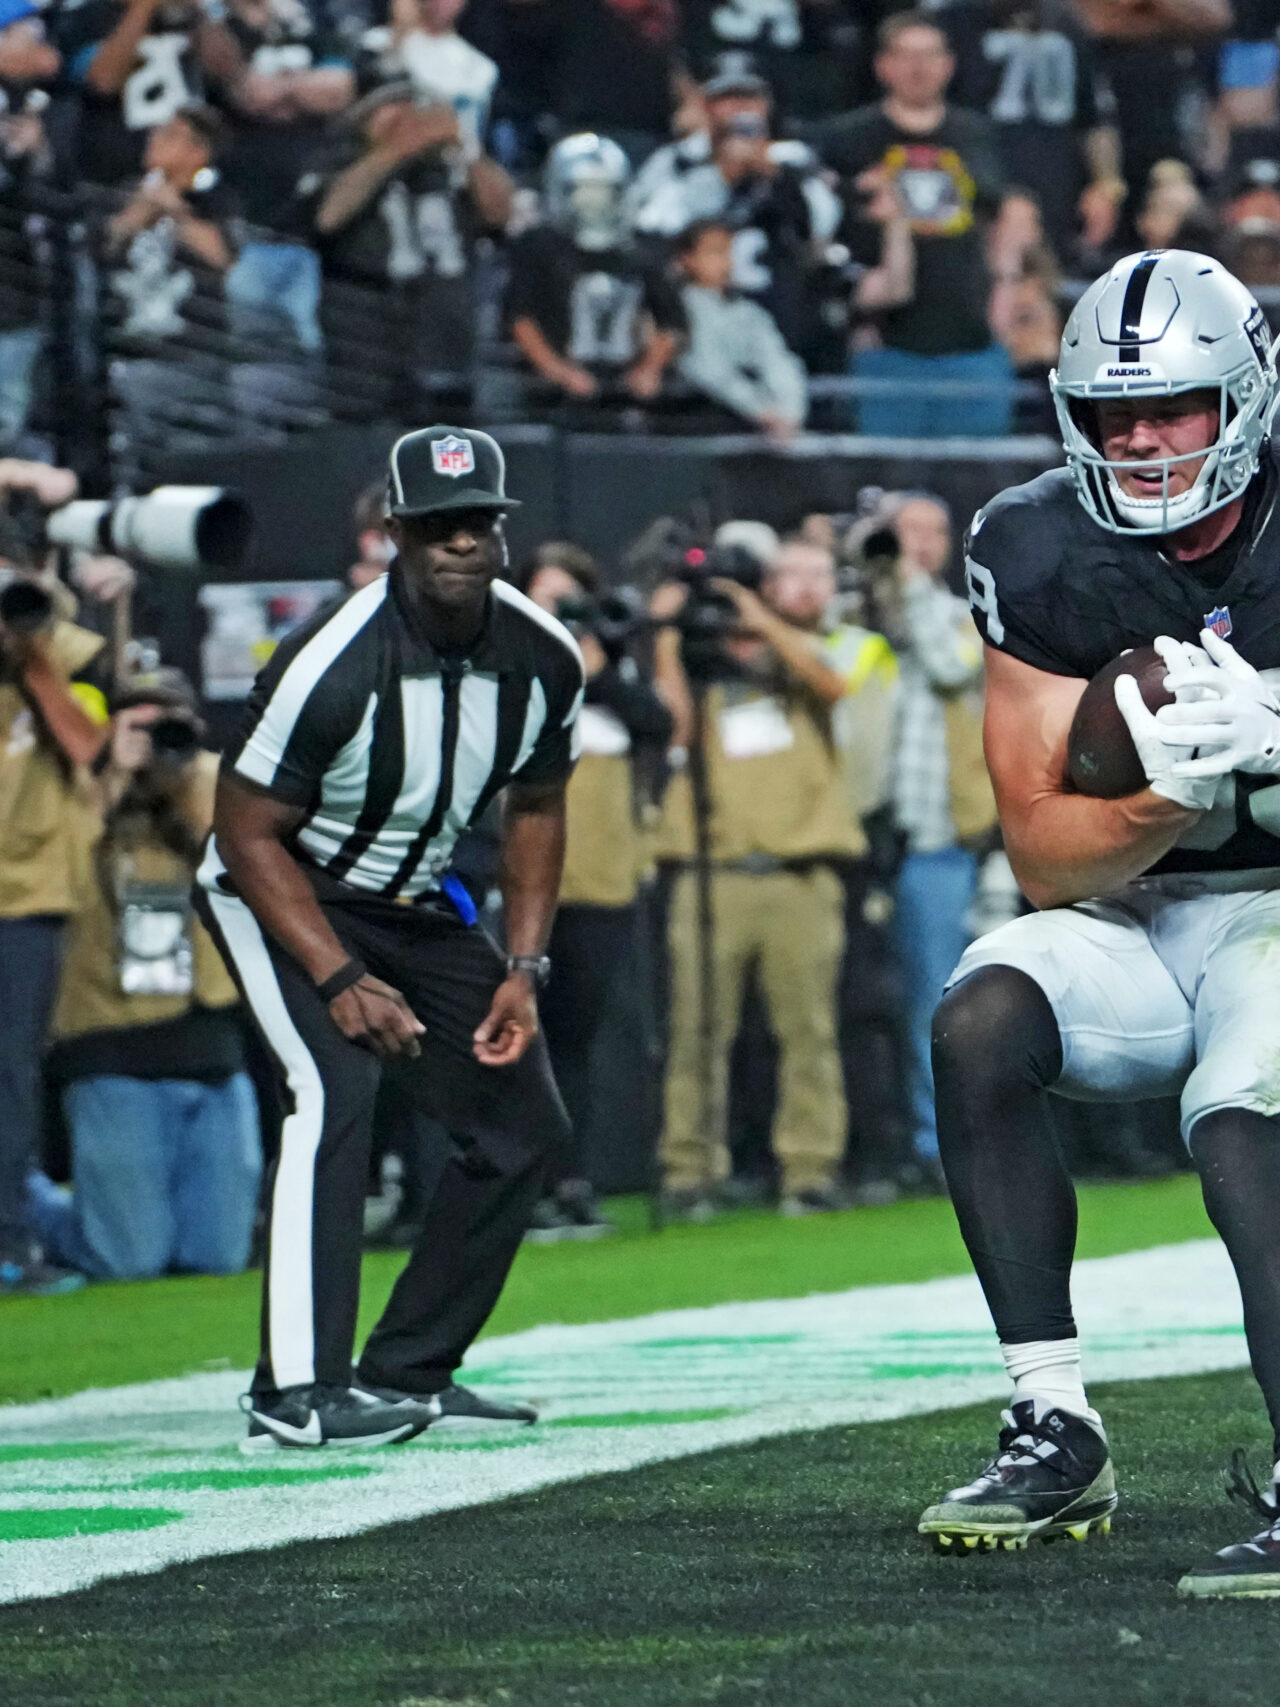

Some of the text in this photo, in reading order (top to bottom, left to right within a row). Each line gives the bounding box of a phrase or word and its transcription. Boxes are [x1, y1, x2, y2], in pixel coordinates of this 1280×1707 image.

[983, 30, 1075, 123] 70
[1107, 367, 1152, 377] RAIDERS
[439, 451, 470, 469] NFL
